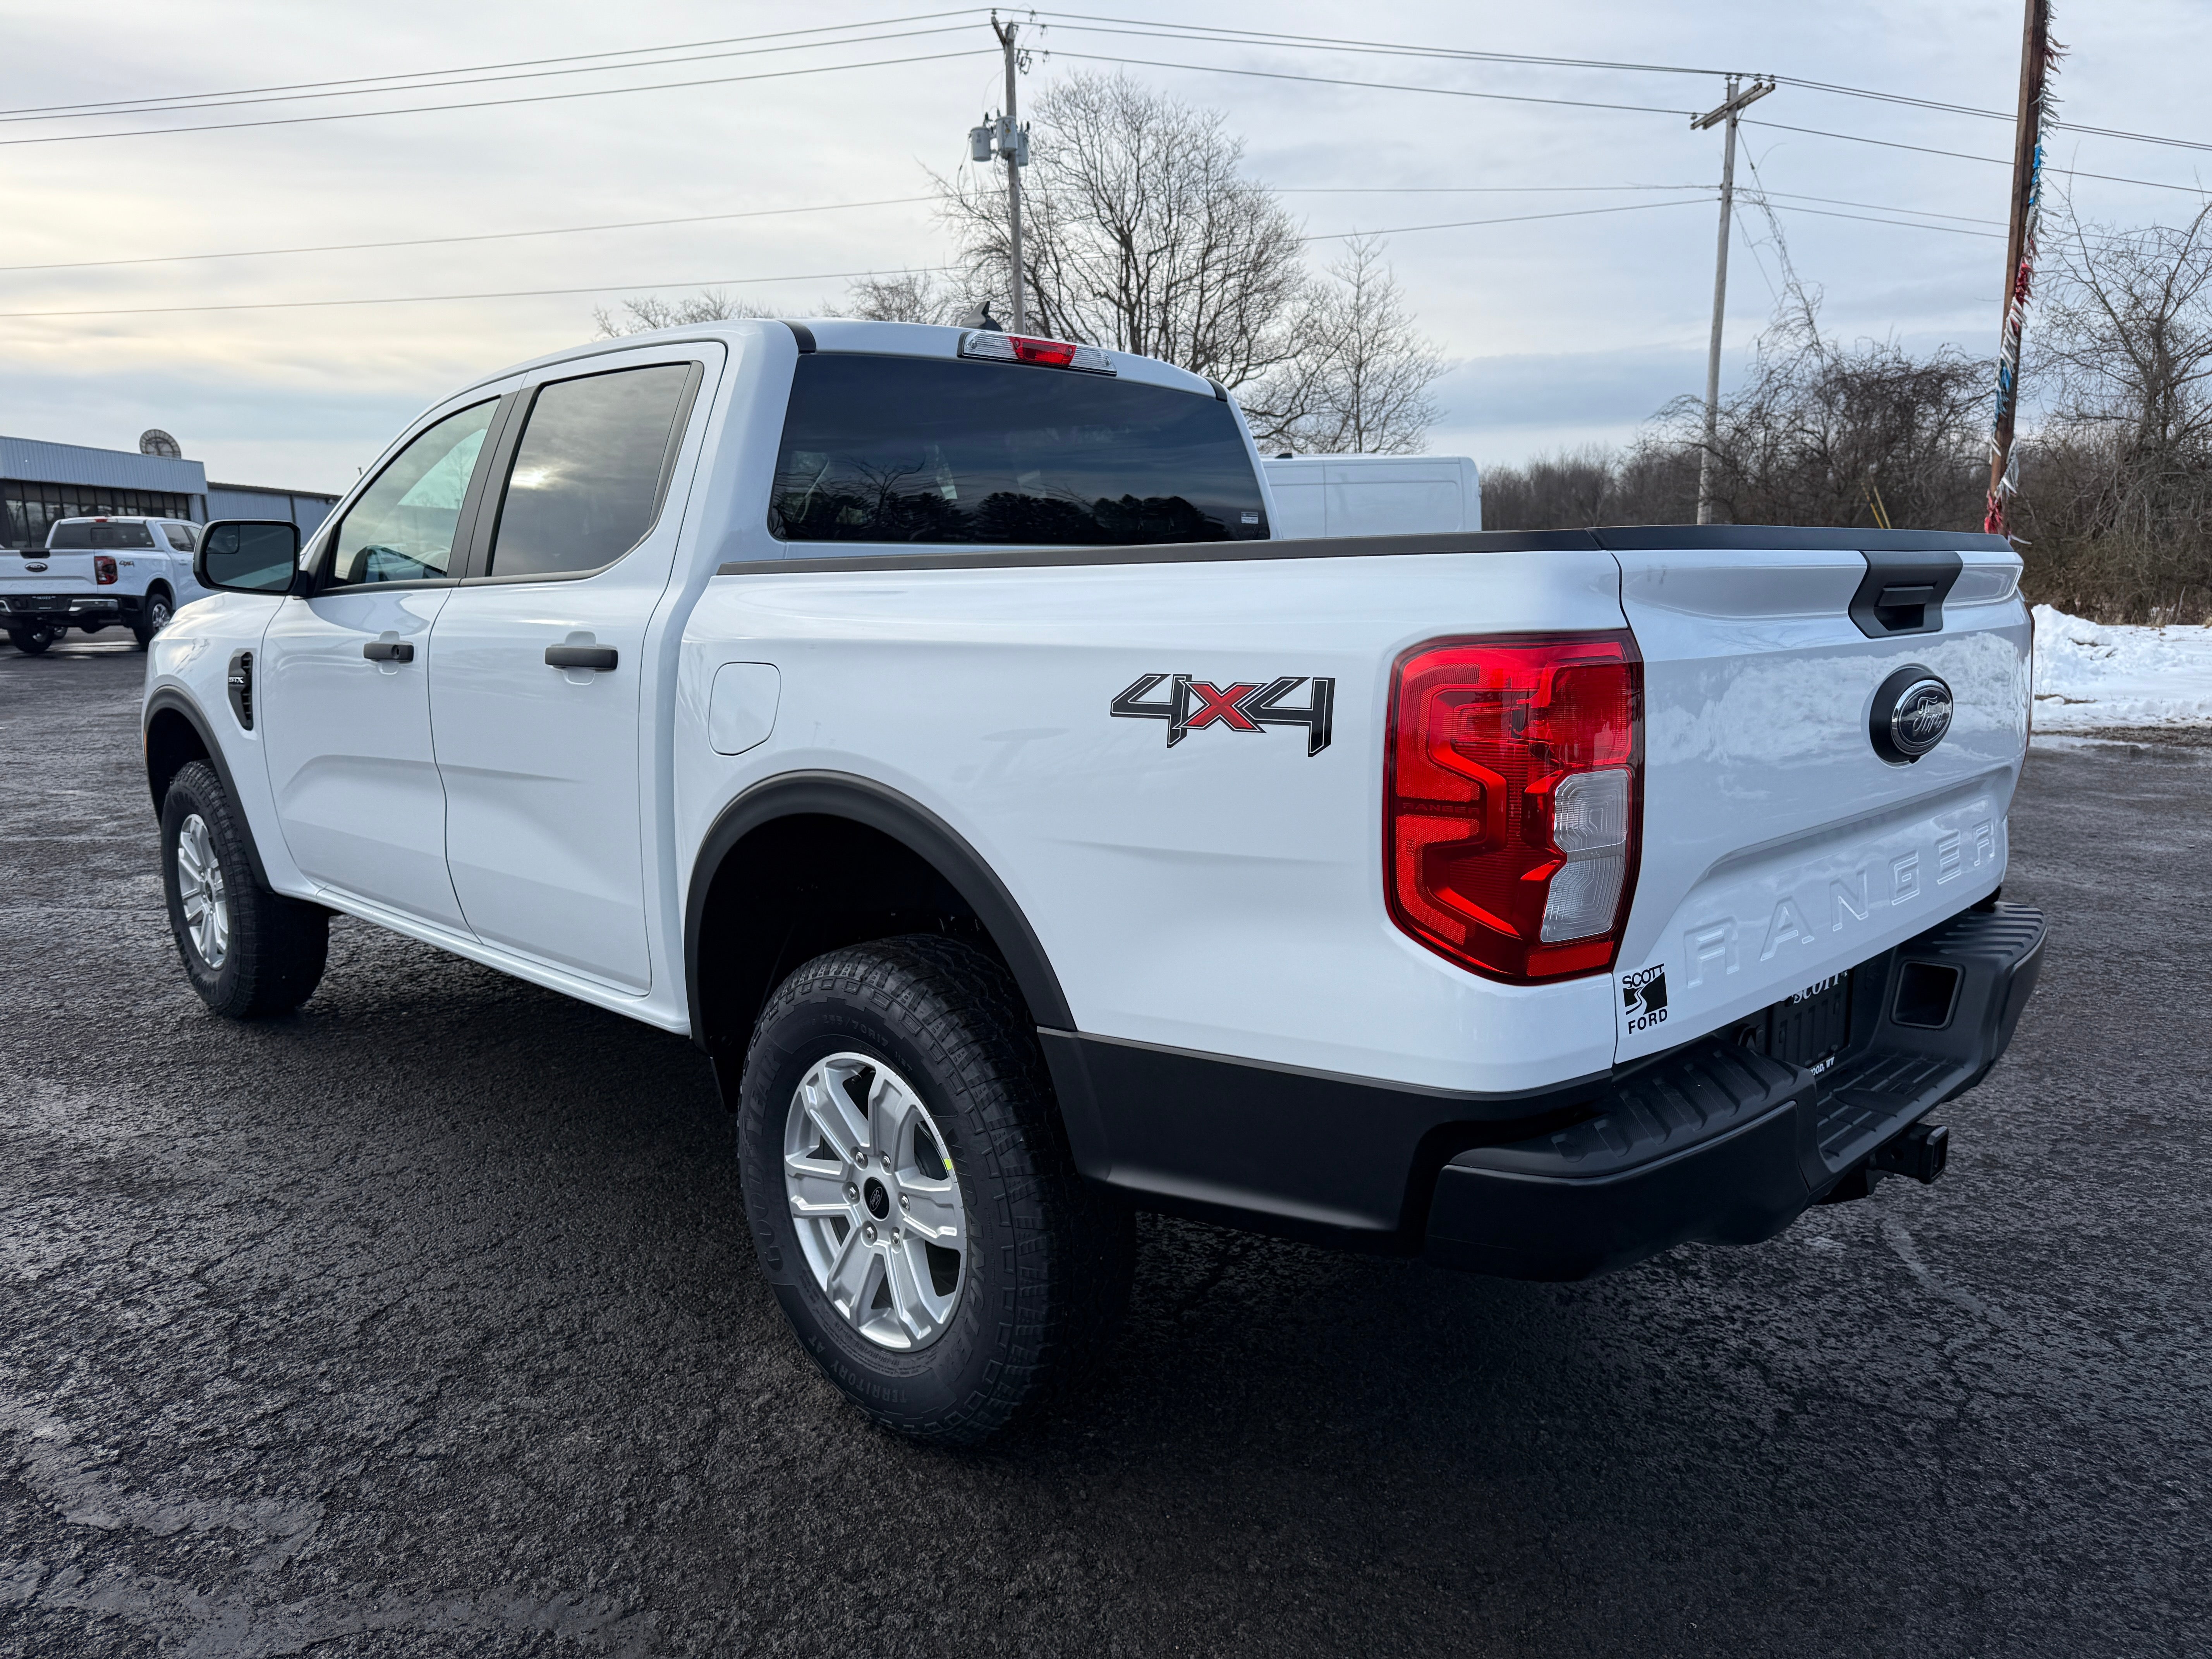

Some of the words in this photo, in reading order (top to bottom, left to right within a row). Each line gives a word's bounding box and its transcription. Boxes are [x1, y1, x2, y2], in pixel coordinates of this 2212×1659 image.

[1403, 802, 1480, 815] RANGER
[1683, 817, 1995, 989] RANGER
[1622, 963, 1664, 988] SCOTT
[1628, 1008, 1668, 1035] FORD
[746, 1047, 783, 1272] GOODYEAR
[808, 1335, 826, 1353] AT
[830, 1360, 907, 1403] TERRITORY
